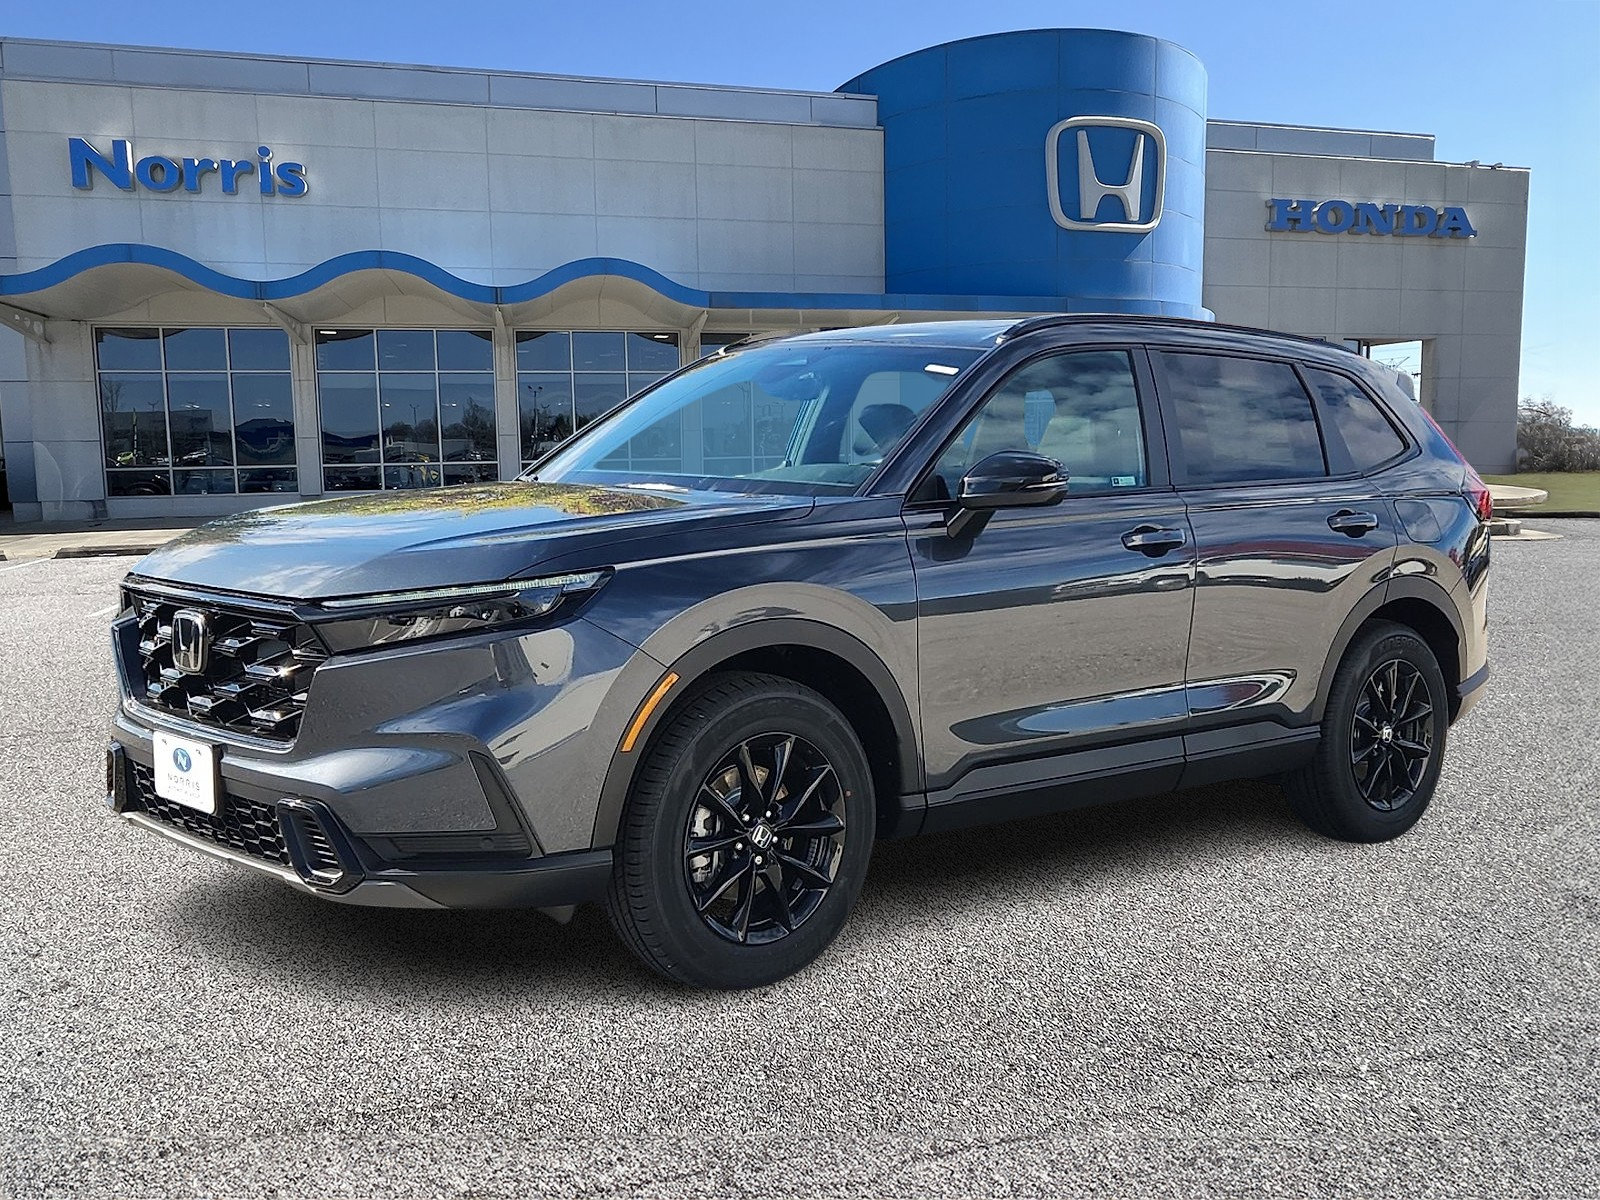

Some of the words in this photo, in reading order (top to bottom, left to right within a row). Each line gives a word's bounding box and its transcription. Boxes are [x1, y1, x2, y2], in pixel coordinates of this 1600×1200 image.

[68, 137, 308, 197] Norris
[1265, 198, 1478, 238] HONDA
[167, 772, 200, 791] NORRIS
